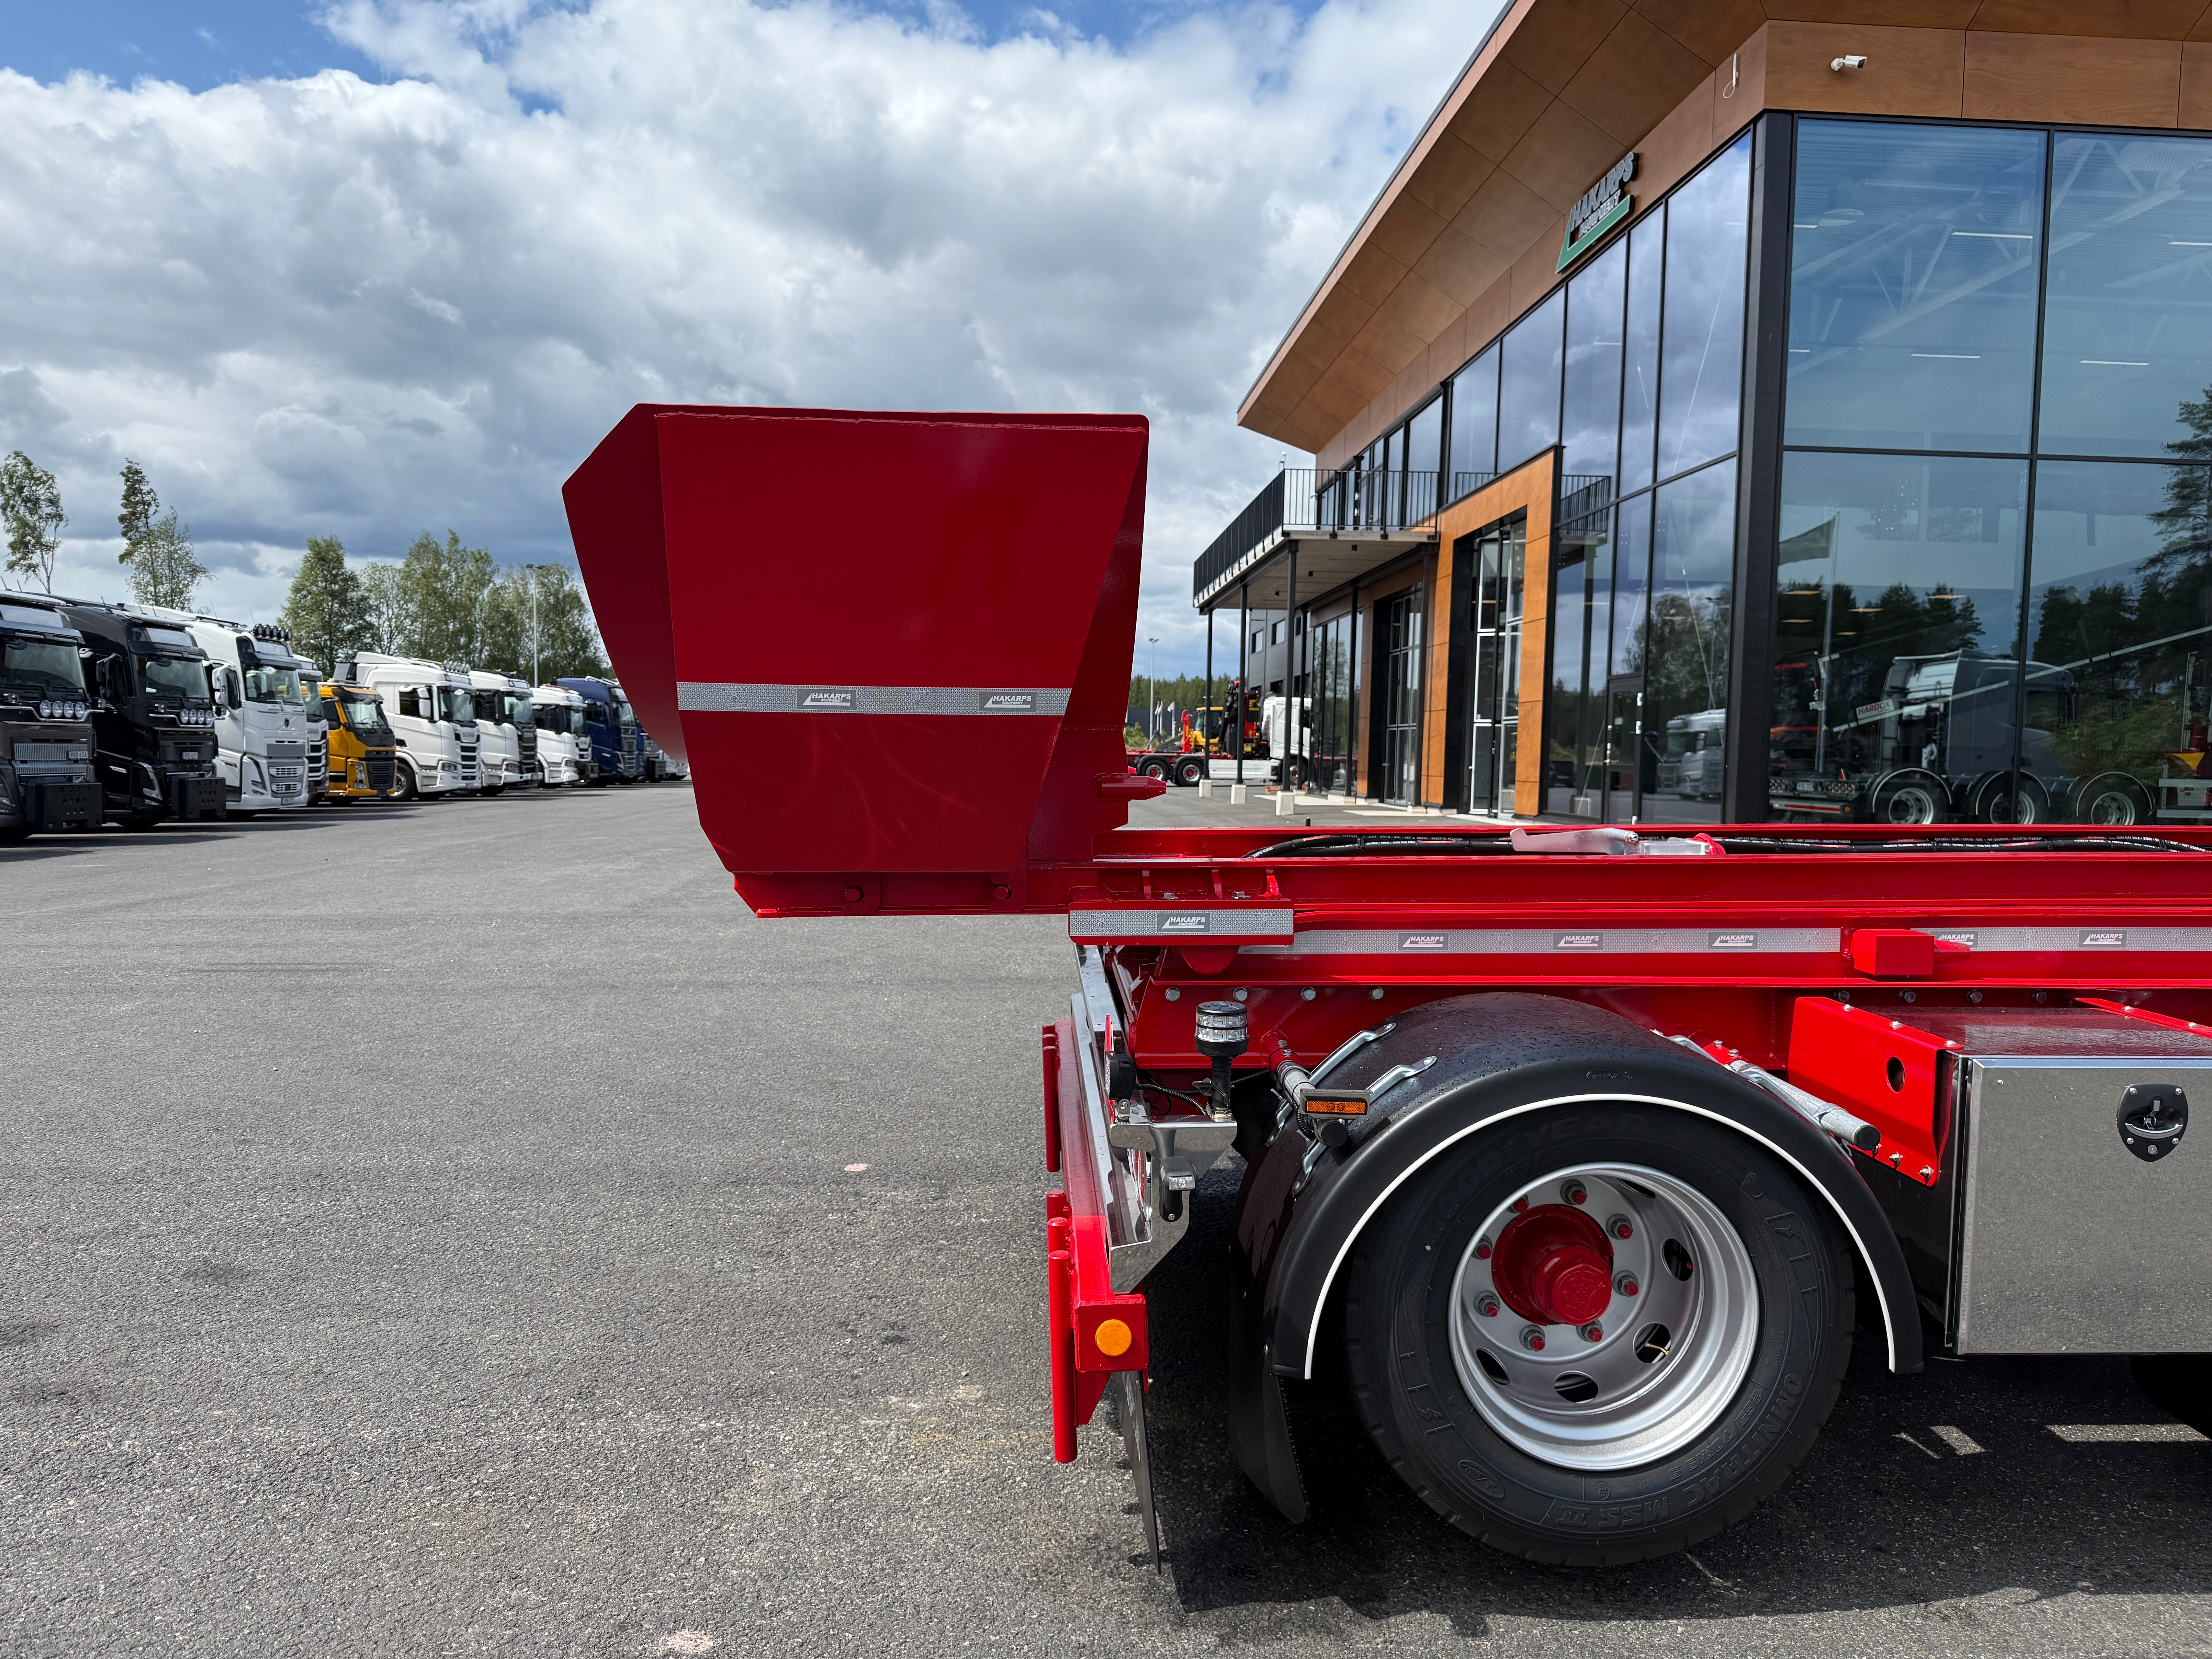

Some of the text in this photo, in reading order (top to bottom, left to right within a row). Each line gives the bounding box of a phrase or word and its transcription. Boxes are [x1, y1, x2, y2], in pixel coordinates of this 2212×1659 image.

[1570, 152, 1634, 232] HAKARPS
[1578, 189, 1621, 239] EQUIPMENT
[1858, 701, 1890, 714] HARDOX
[1669, 1389, 1762, 1480] 265/70R19.5
[1683, 1373, 1805, 1507] OMNITRAC
[1598, 1496, 1670, 1528] MSS
